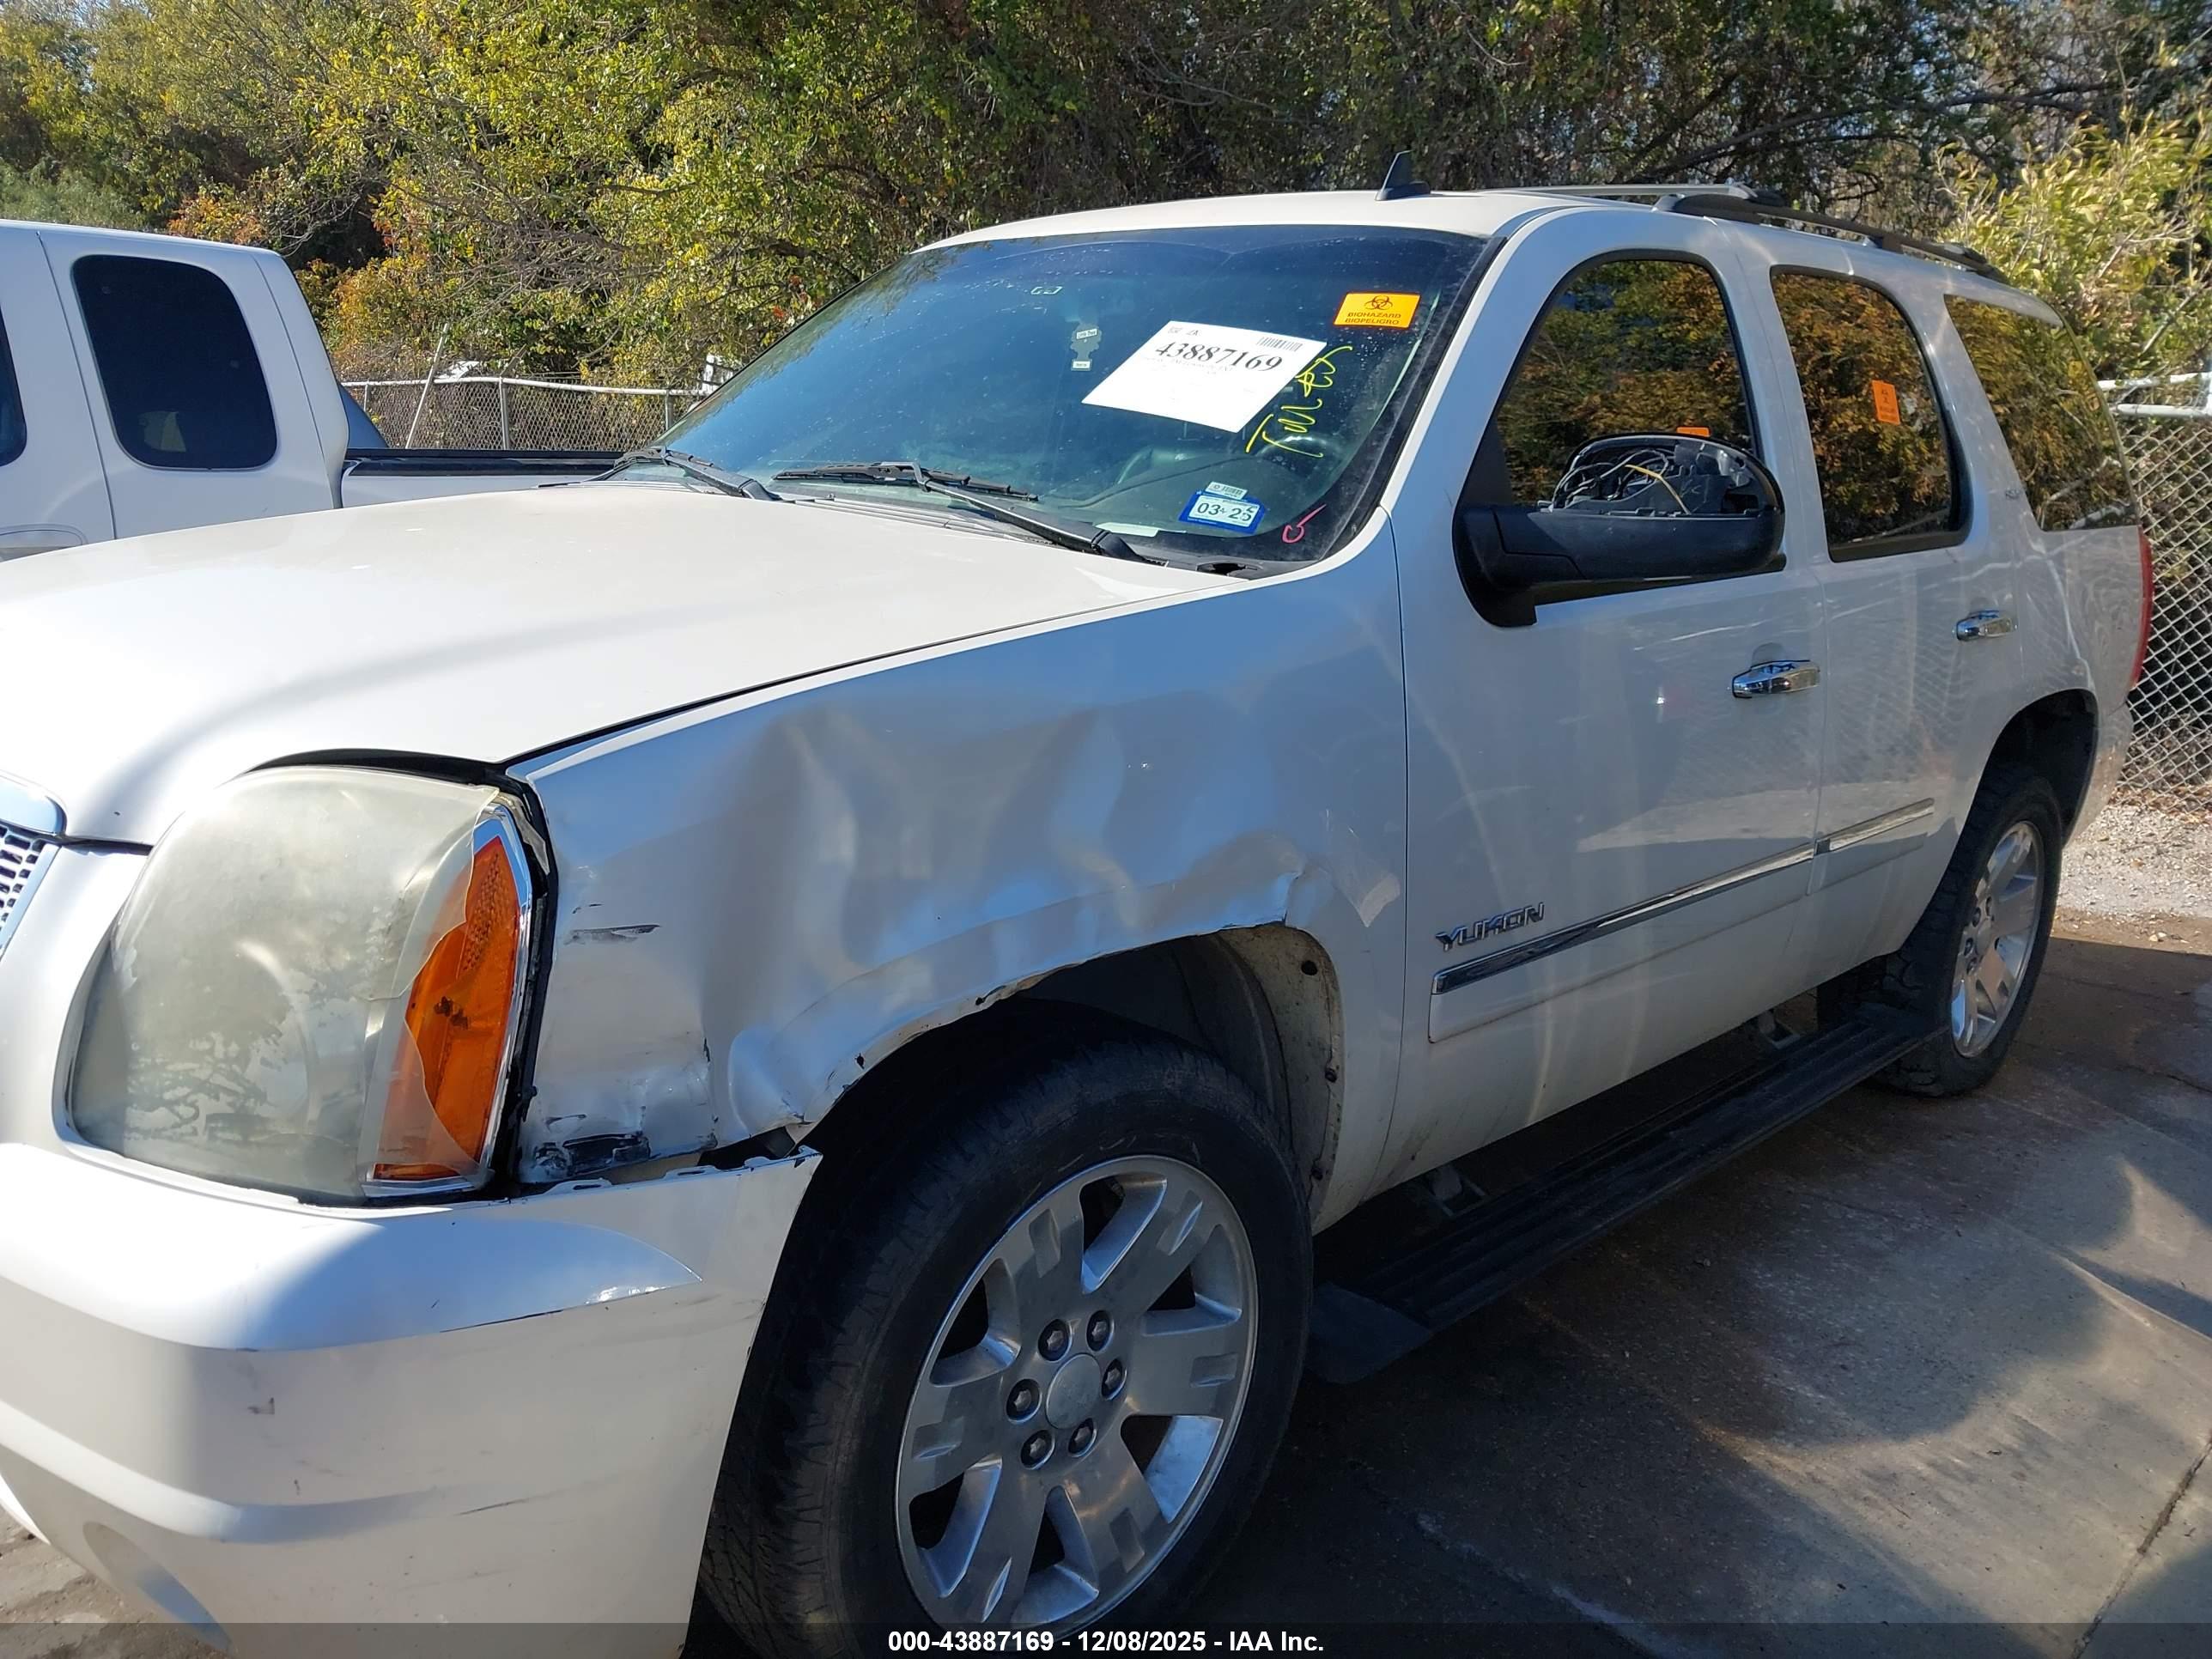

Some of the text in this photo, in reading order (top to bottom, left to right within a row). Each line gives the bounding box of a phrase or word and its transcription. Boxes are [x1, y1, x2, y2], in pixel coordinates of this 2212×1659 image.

[1155, 342, 1283, 372] 43887169
[1196, 502, 1222, 516] 03
[1435, 902, 1546, 951] YUKON
